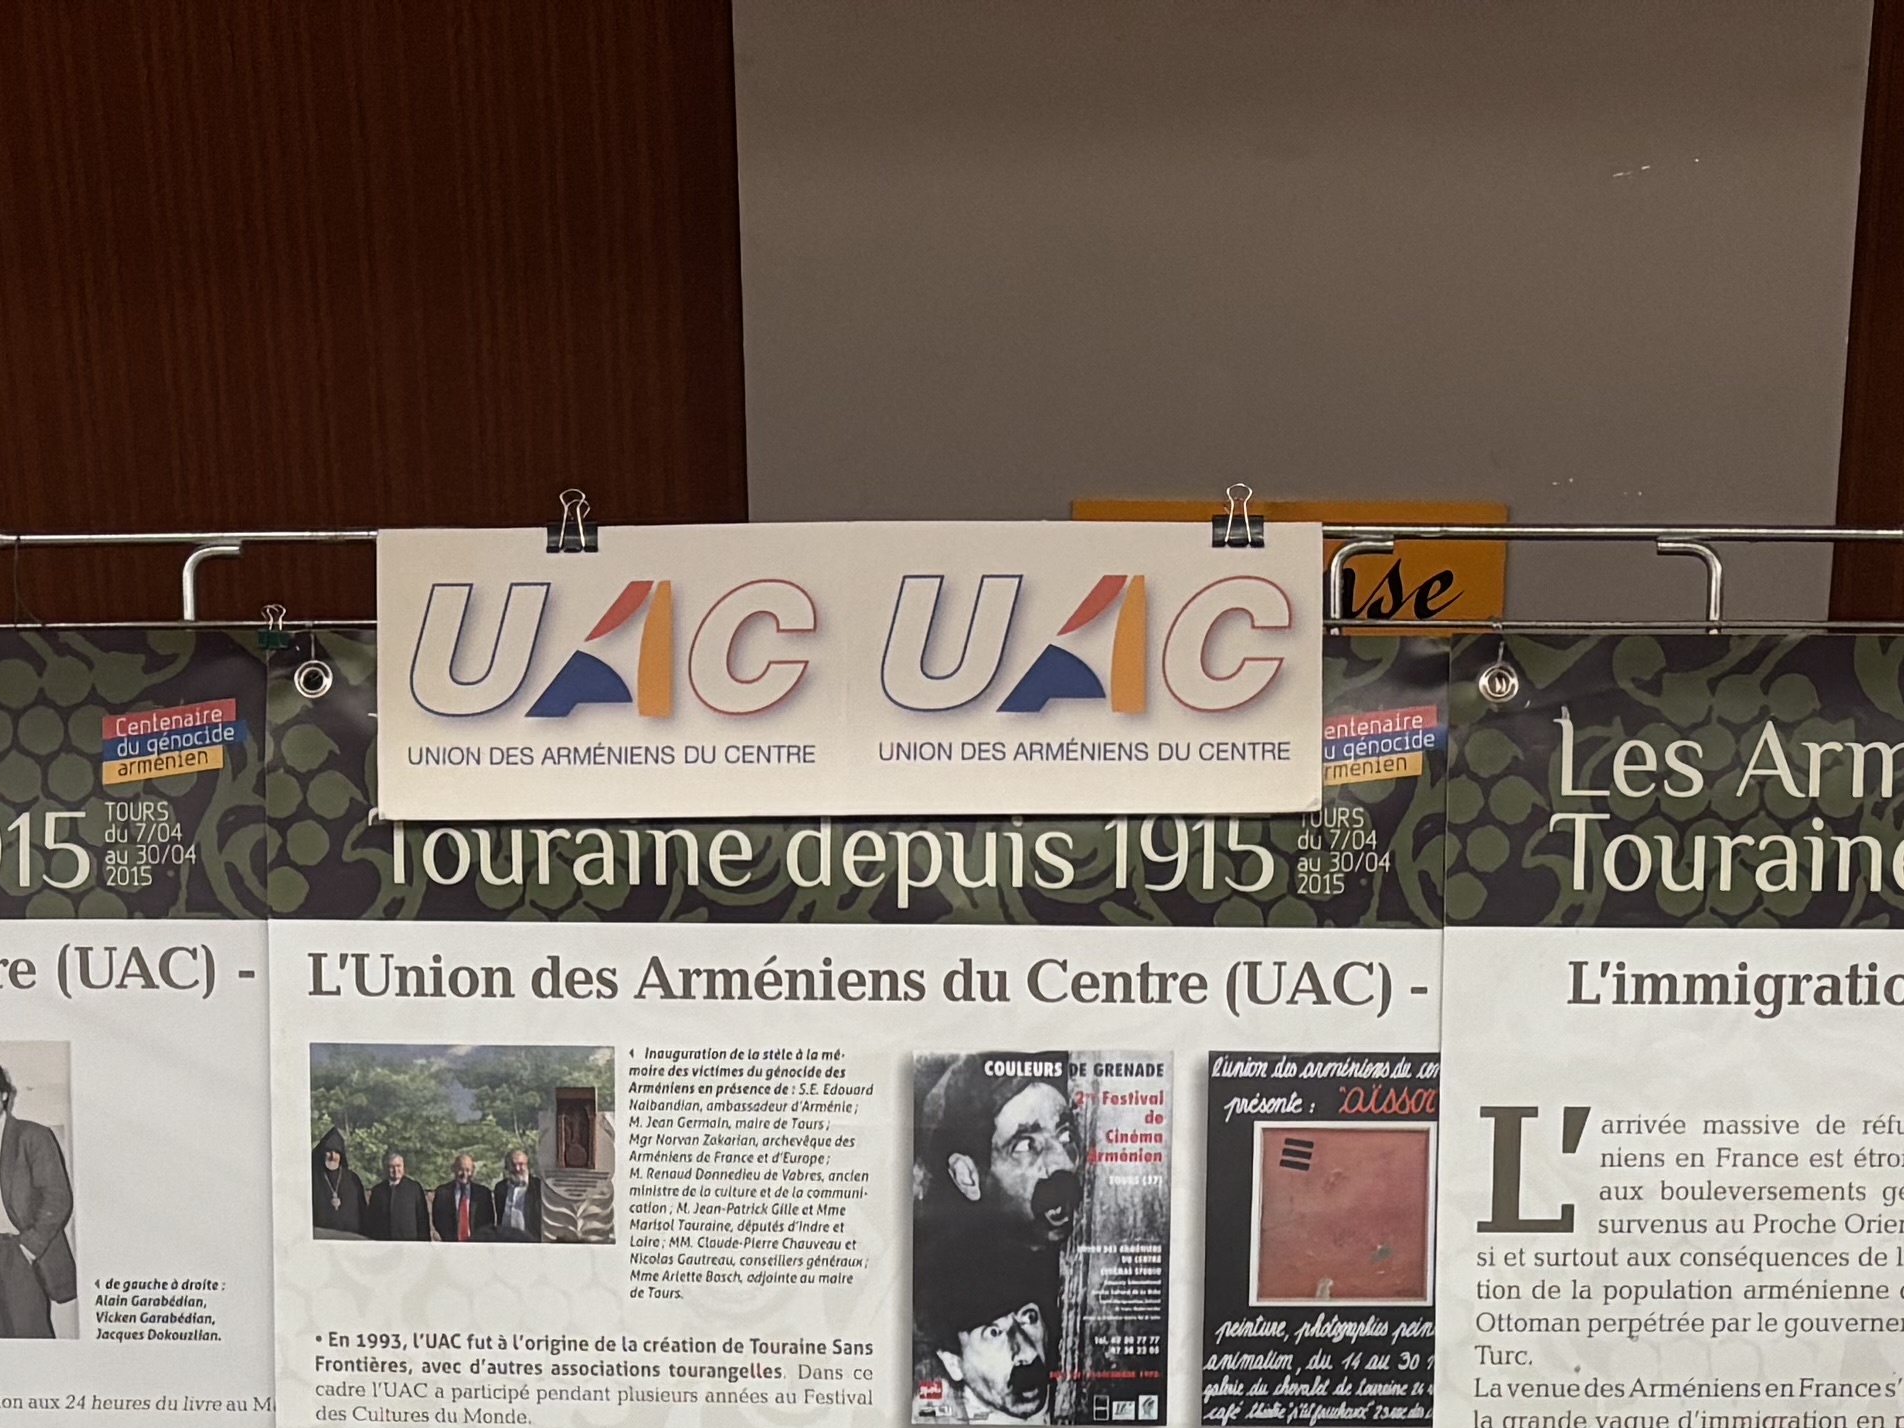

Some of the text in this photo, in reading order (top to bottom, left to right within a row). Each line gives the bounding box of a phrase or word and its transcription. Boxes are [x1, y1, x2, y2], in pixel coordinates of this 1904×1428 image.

[410, 576, 817, 718] UAC
[881, 575, 1293, 715] UAC
[116, 707, 223, 737] Centenaire
[117, 724, 235, 758] du génocide
[879, 737, 1291, 762] UNION DES ARMÉNIENS DU CENTRE
[408, 741, 816, 766] UNION DES ARMÉNIENS DU CENTRE
[1555, 706, 1703, 799] Les
[382, 816, 1277, 909] Touraine depuis 1915
[57, 943, 216, 1000] (UAC)
[308, 952, 1392, 1018] L'Union des Arméniens du Centre (UAC)
[984, 1060, 1164, 1078] COULEURS DE GRENADE
